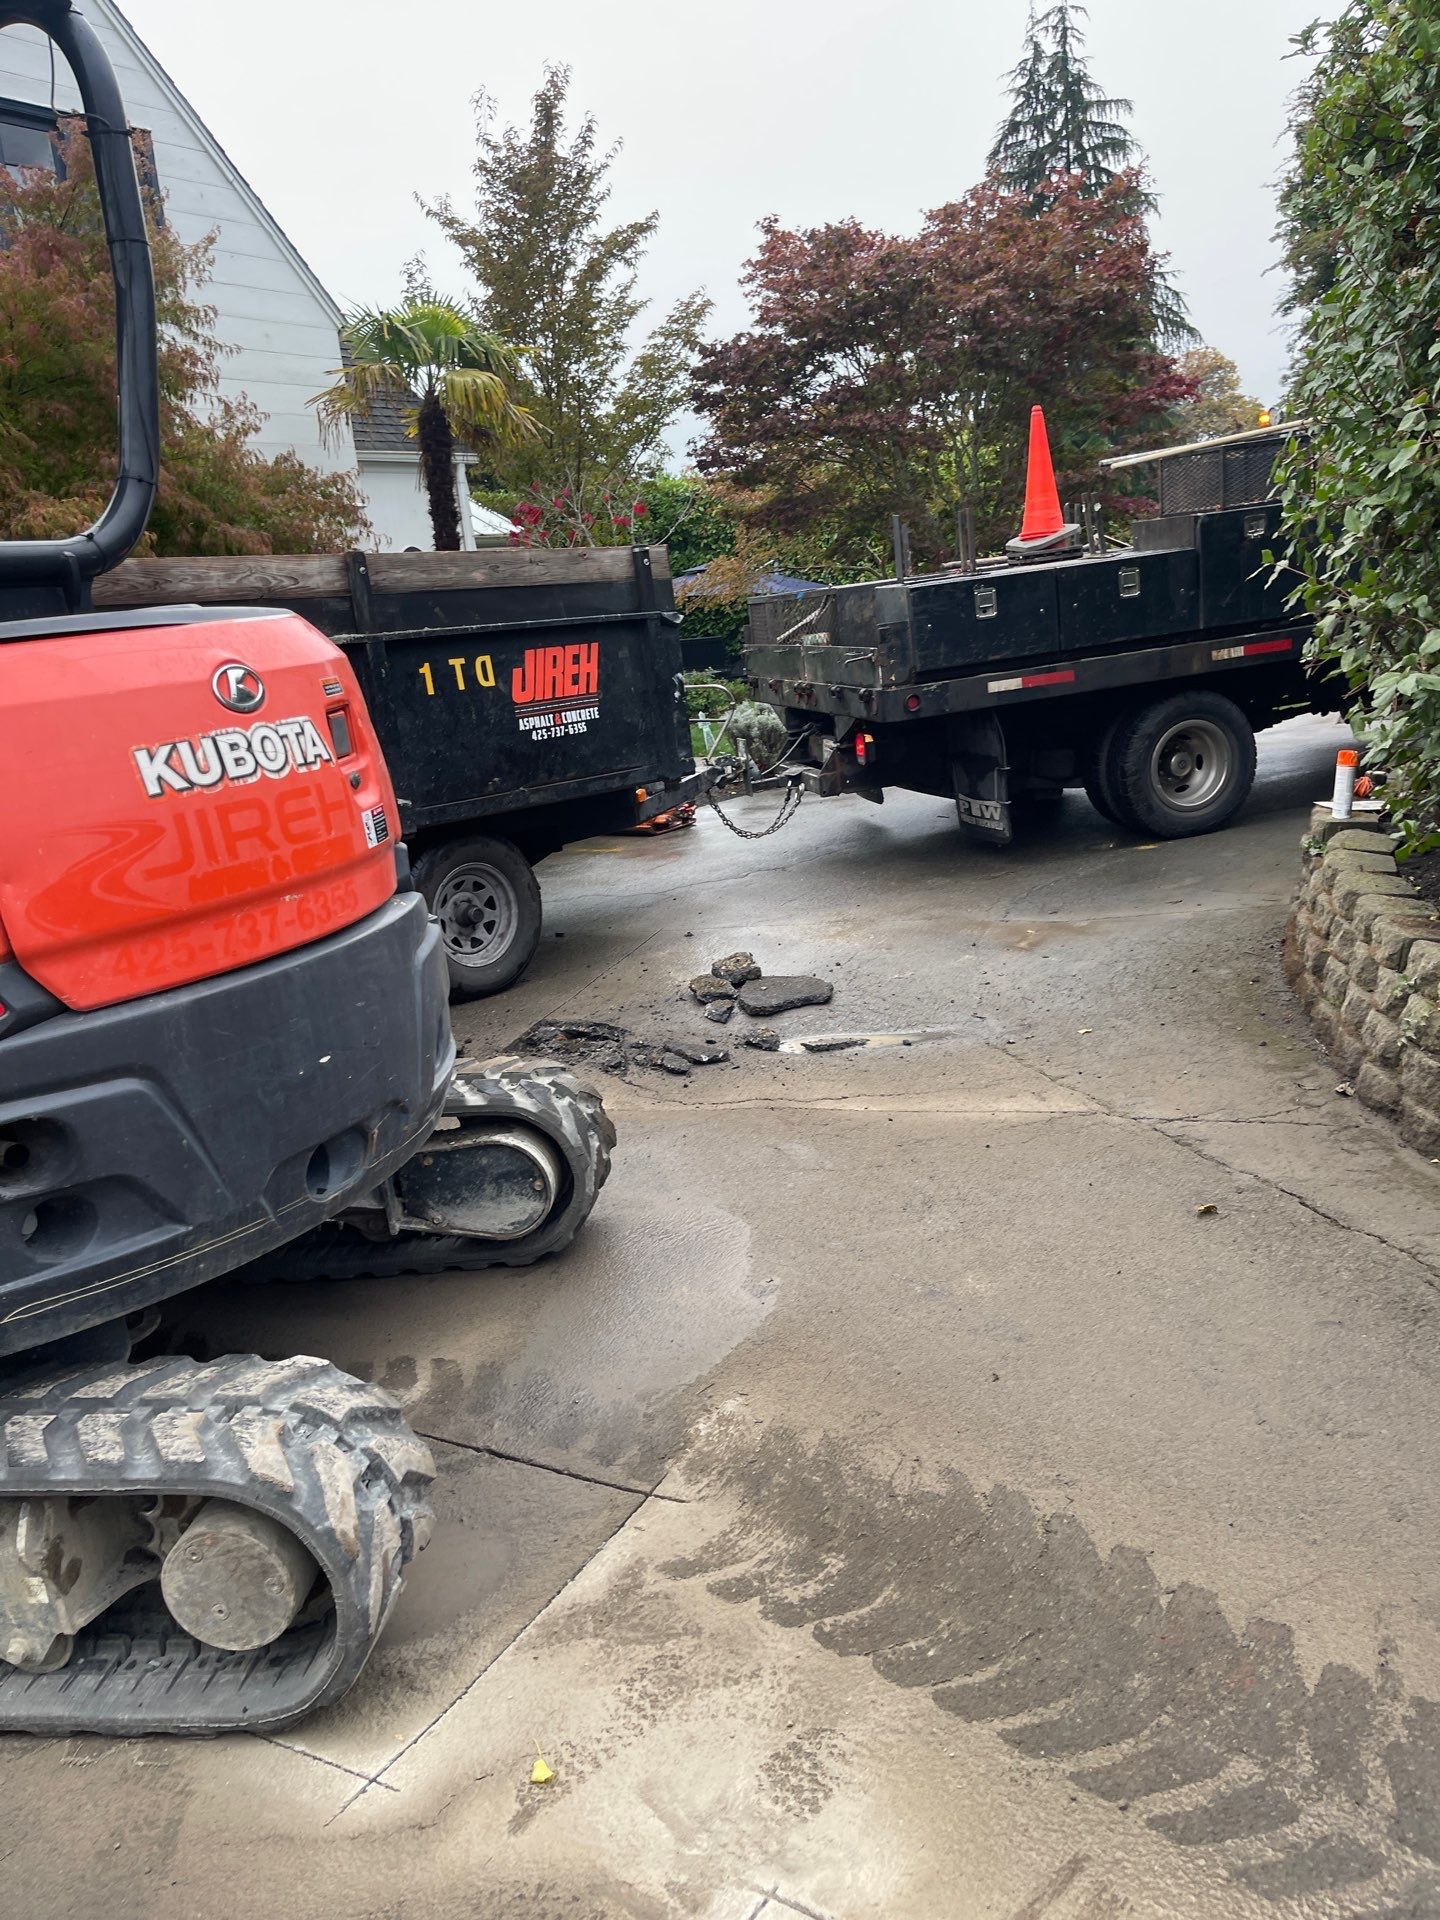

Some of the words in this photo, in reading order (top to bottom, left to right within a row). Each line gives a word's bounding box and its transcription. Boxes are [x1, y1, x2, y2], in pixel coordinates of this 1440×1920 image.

[512, 642, 599, 703] JIREH
[518, 714, 554, 731] ASPHALT
[554, 712, 562, 725] &
[561, 707, 600, 724] CONCRETE
[531, 722, 588, 741] 425-737-6355
[132, 718, 332, 798] KUBOTA
[141, 779, 356, 882] JIREH
[113, 881, 359, 979] 425-737-6355
